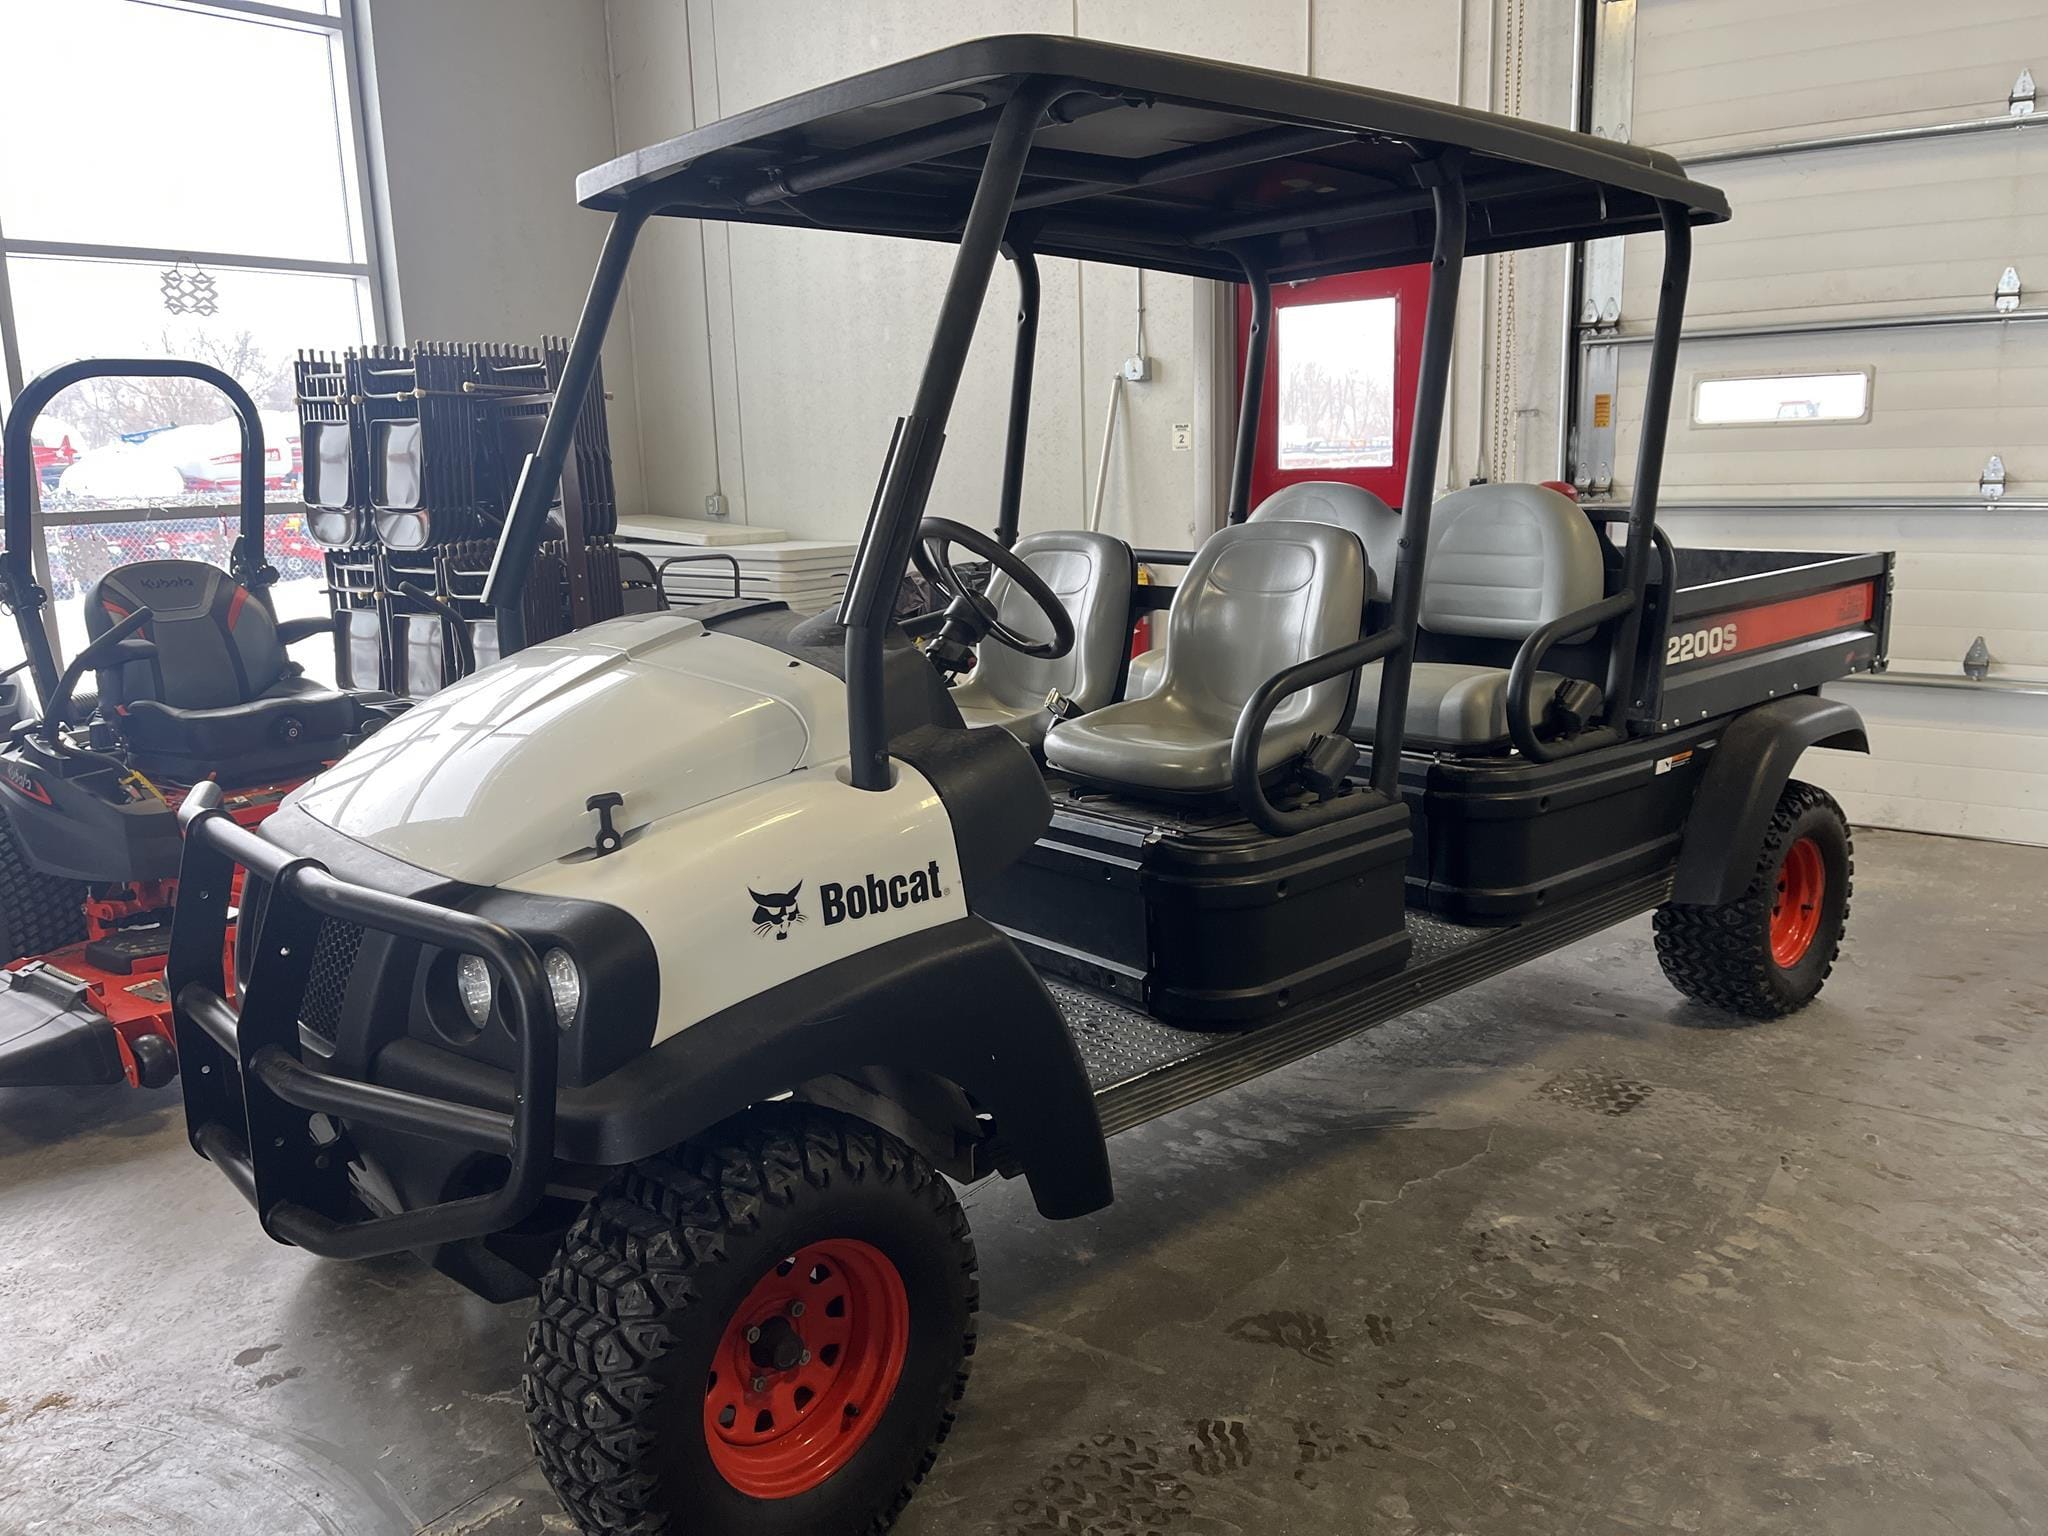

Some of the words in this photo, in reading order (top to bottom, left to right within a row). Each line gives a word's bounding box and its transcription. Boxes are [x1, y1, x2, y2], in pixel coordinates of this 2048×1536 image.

[1179, 434, 1185, 444] 2
[140, 576, 194, 589] Kubota
[1665, 623, 1737, 665] 2200S
[819, 860, 943, 926] Bobcat
